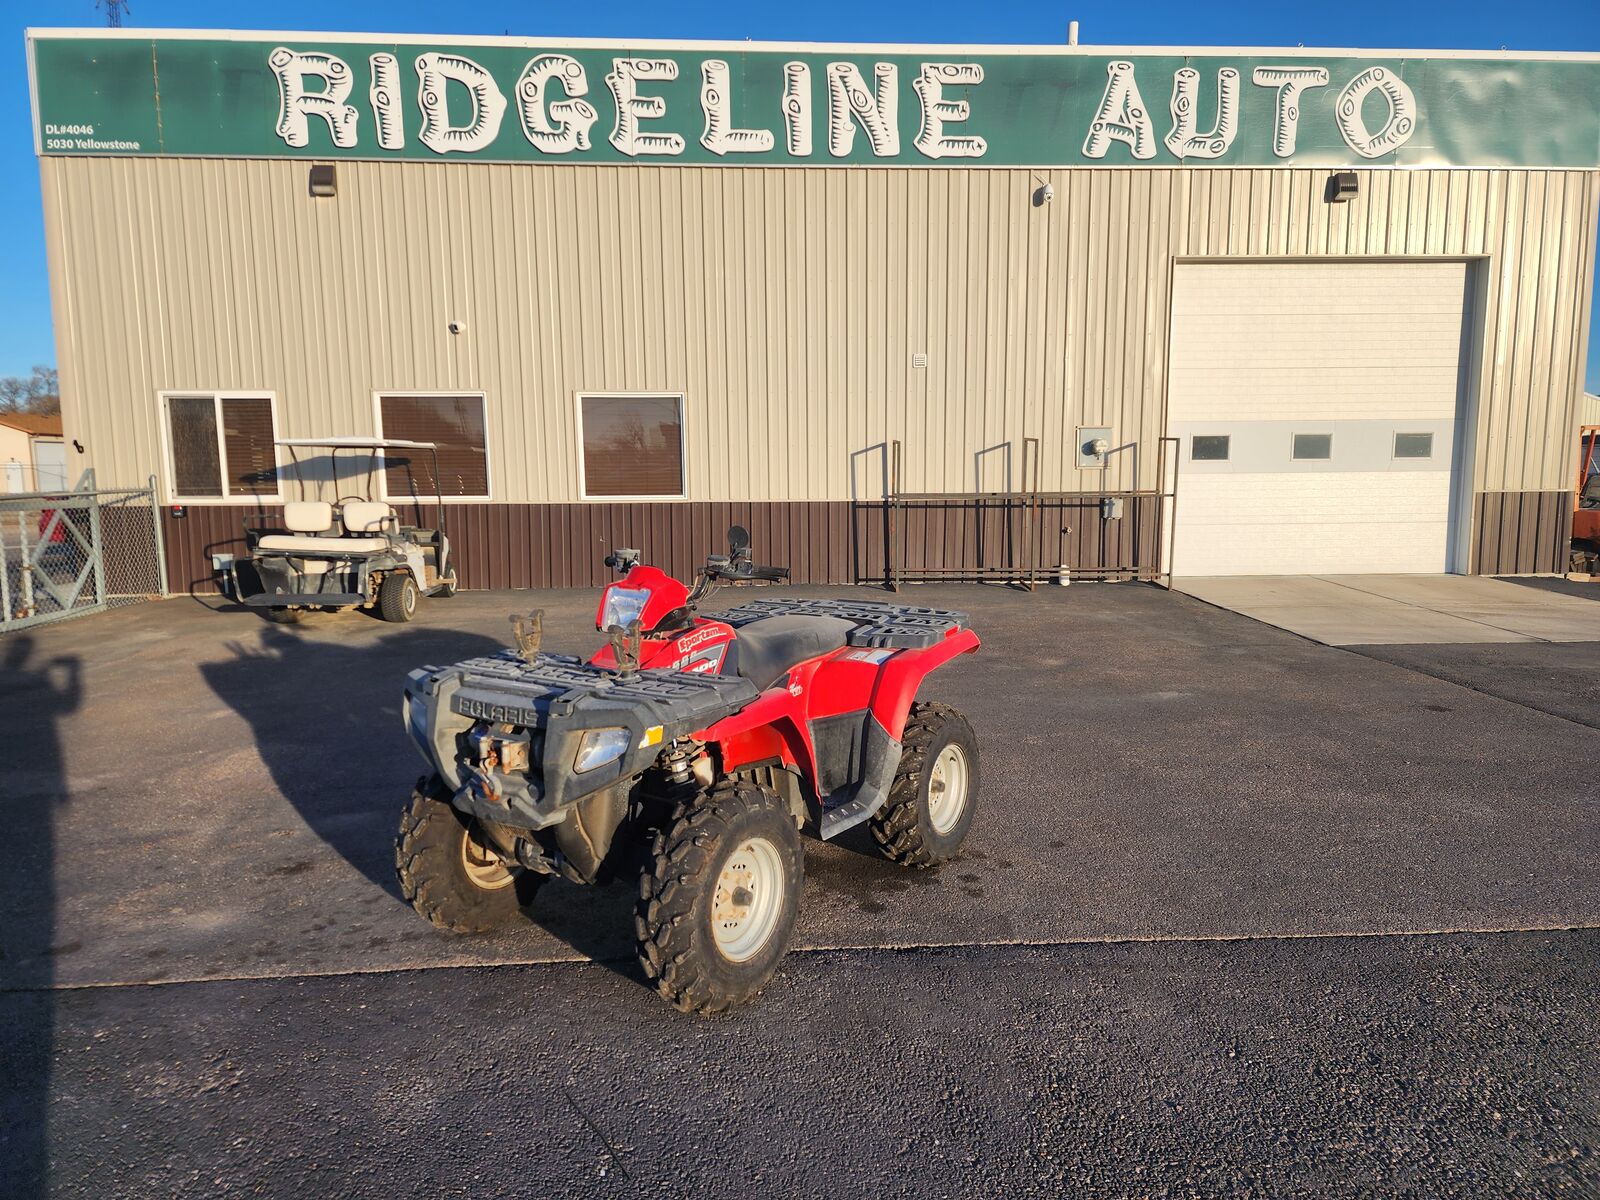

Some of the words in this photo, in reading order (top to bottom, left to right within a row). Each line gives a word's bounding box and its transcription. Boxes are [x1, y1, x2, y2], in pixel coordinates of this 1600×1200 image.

[268, 46, 988, 159] RIDGELINE
[1082, 60, 1417, 160] AUTO
[45, 124, 94, 135] DL#4046
[47, 139, 74, 149] 5030
[75, 139, 140, 150] Yellowstone
[459, 697, 538, 728] POLARIS
